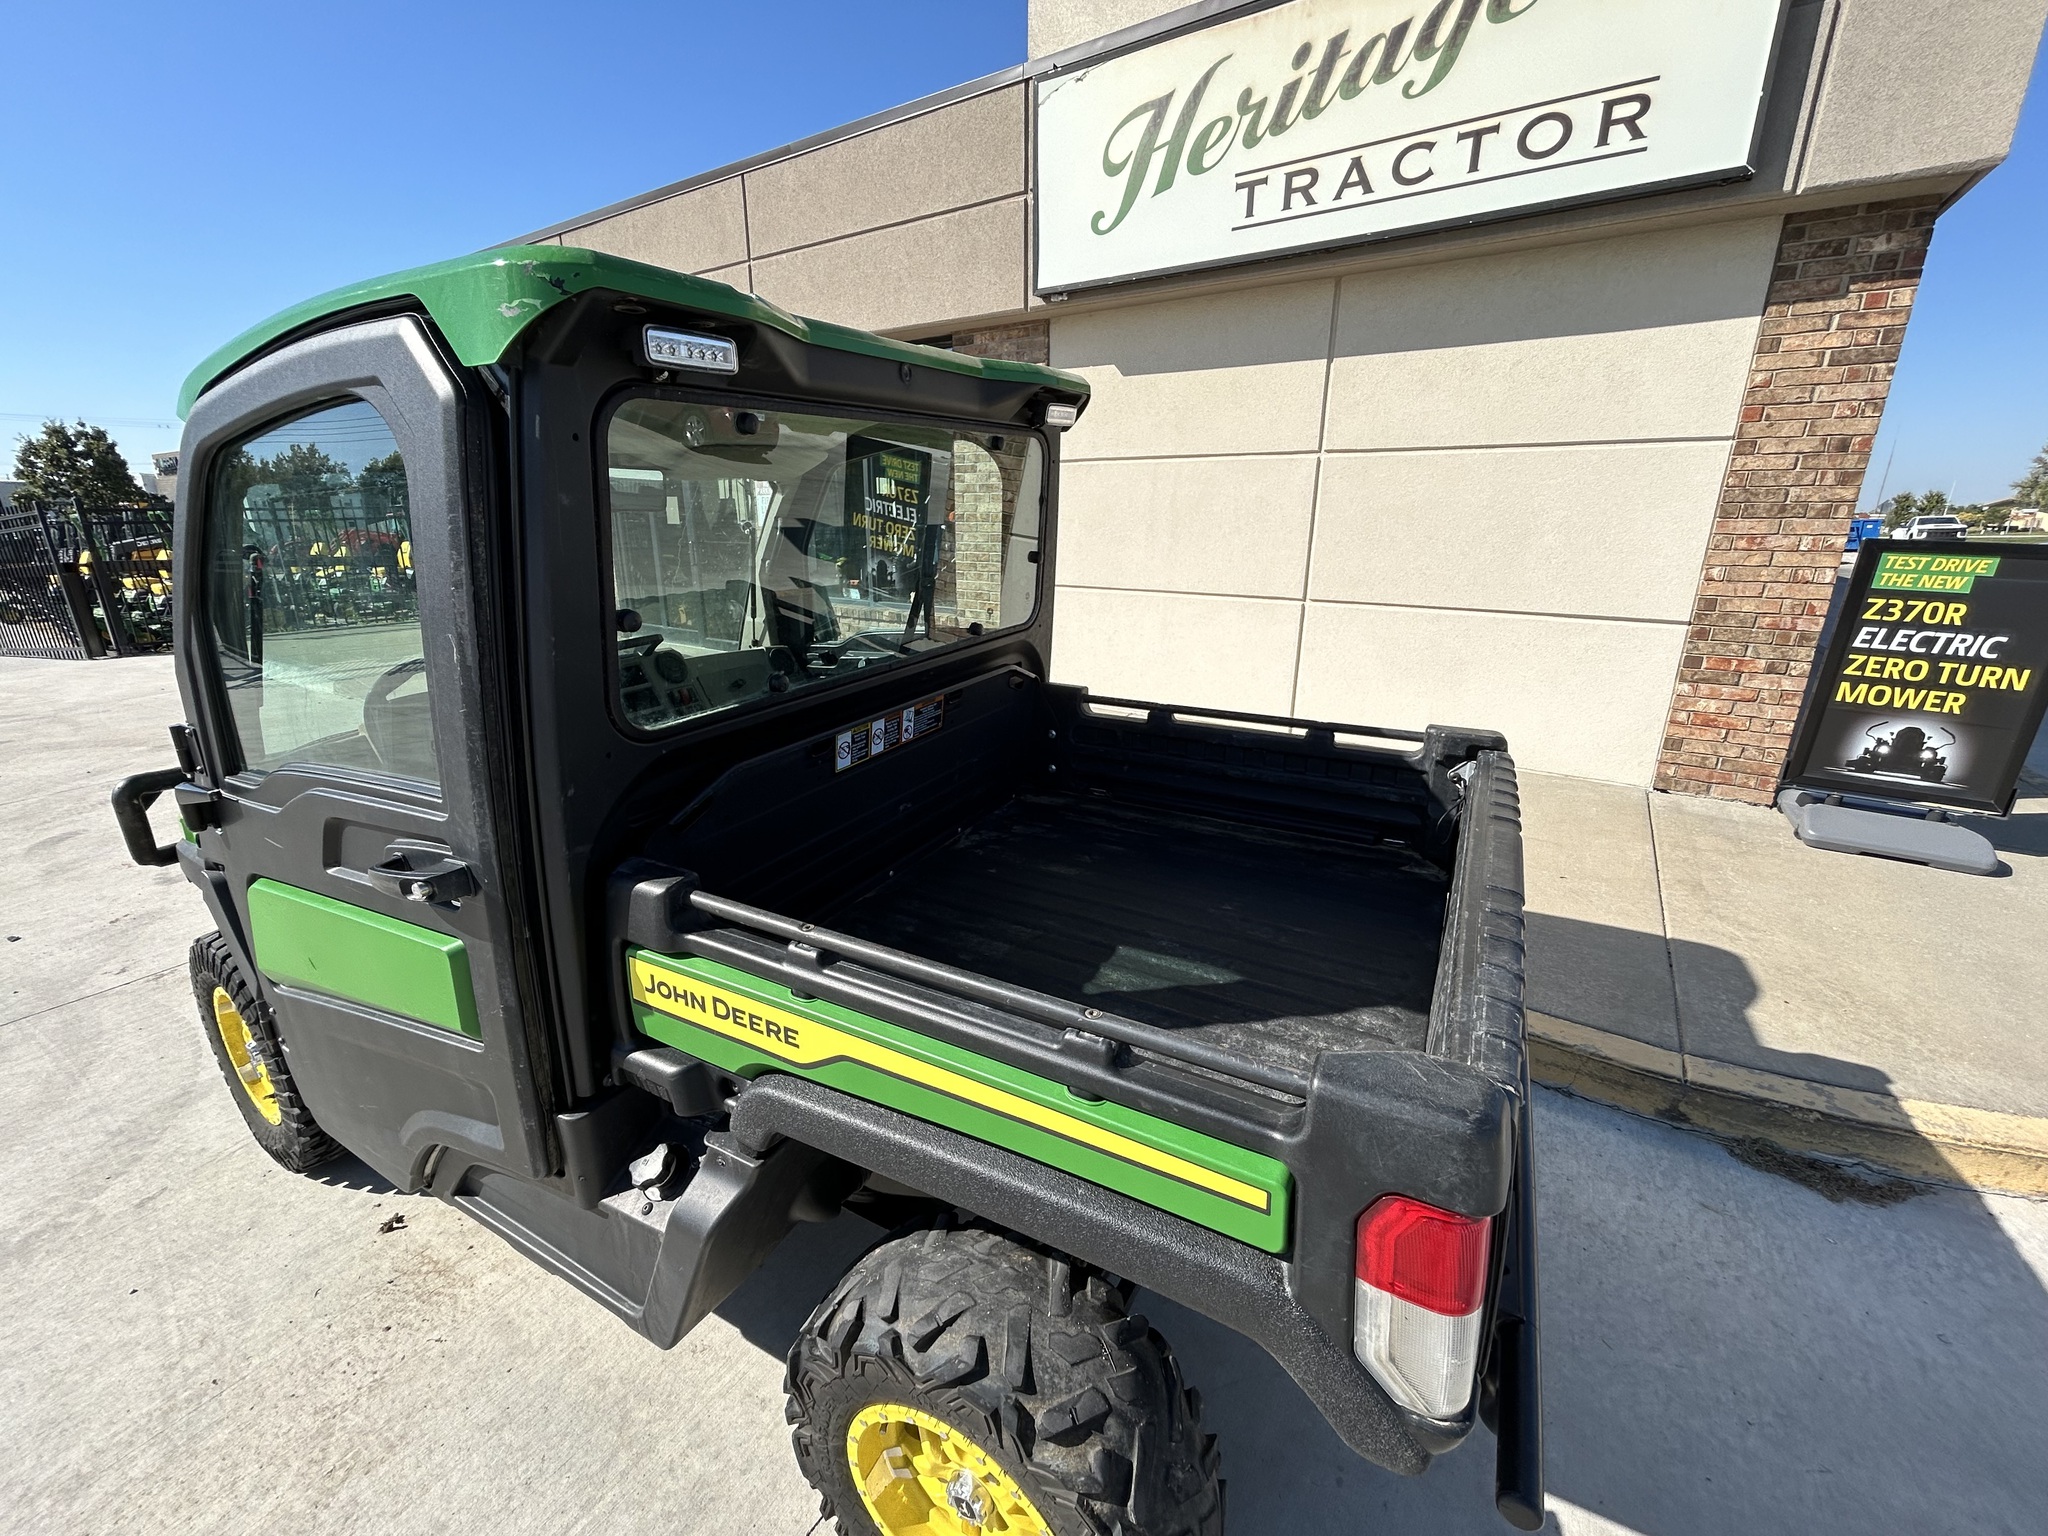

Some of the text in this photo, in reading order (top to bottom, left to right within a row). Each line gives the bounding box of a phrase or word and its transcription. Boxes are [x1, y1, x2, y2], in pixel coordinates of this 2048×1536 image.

[1235, 93, 1652, 218] TRACTOR
[1879, 573, 1970, 590] THE NEW
[1884, 556, 1994, 574] TEST DRIVE
[1861, 597, 1968, 626] Z370R
[1851, 627, 2010, 659] ELECTRIC
[1843, 654, 2031, 692] ZERO TURN
[1835, 681, 1967, 715] MOWER
[644, 974, 800, 1049] JOHN DEERE
